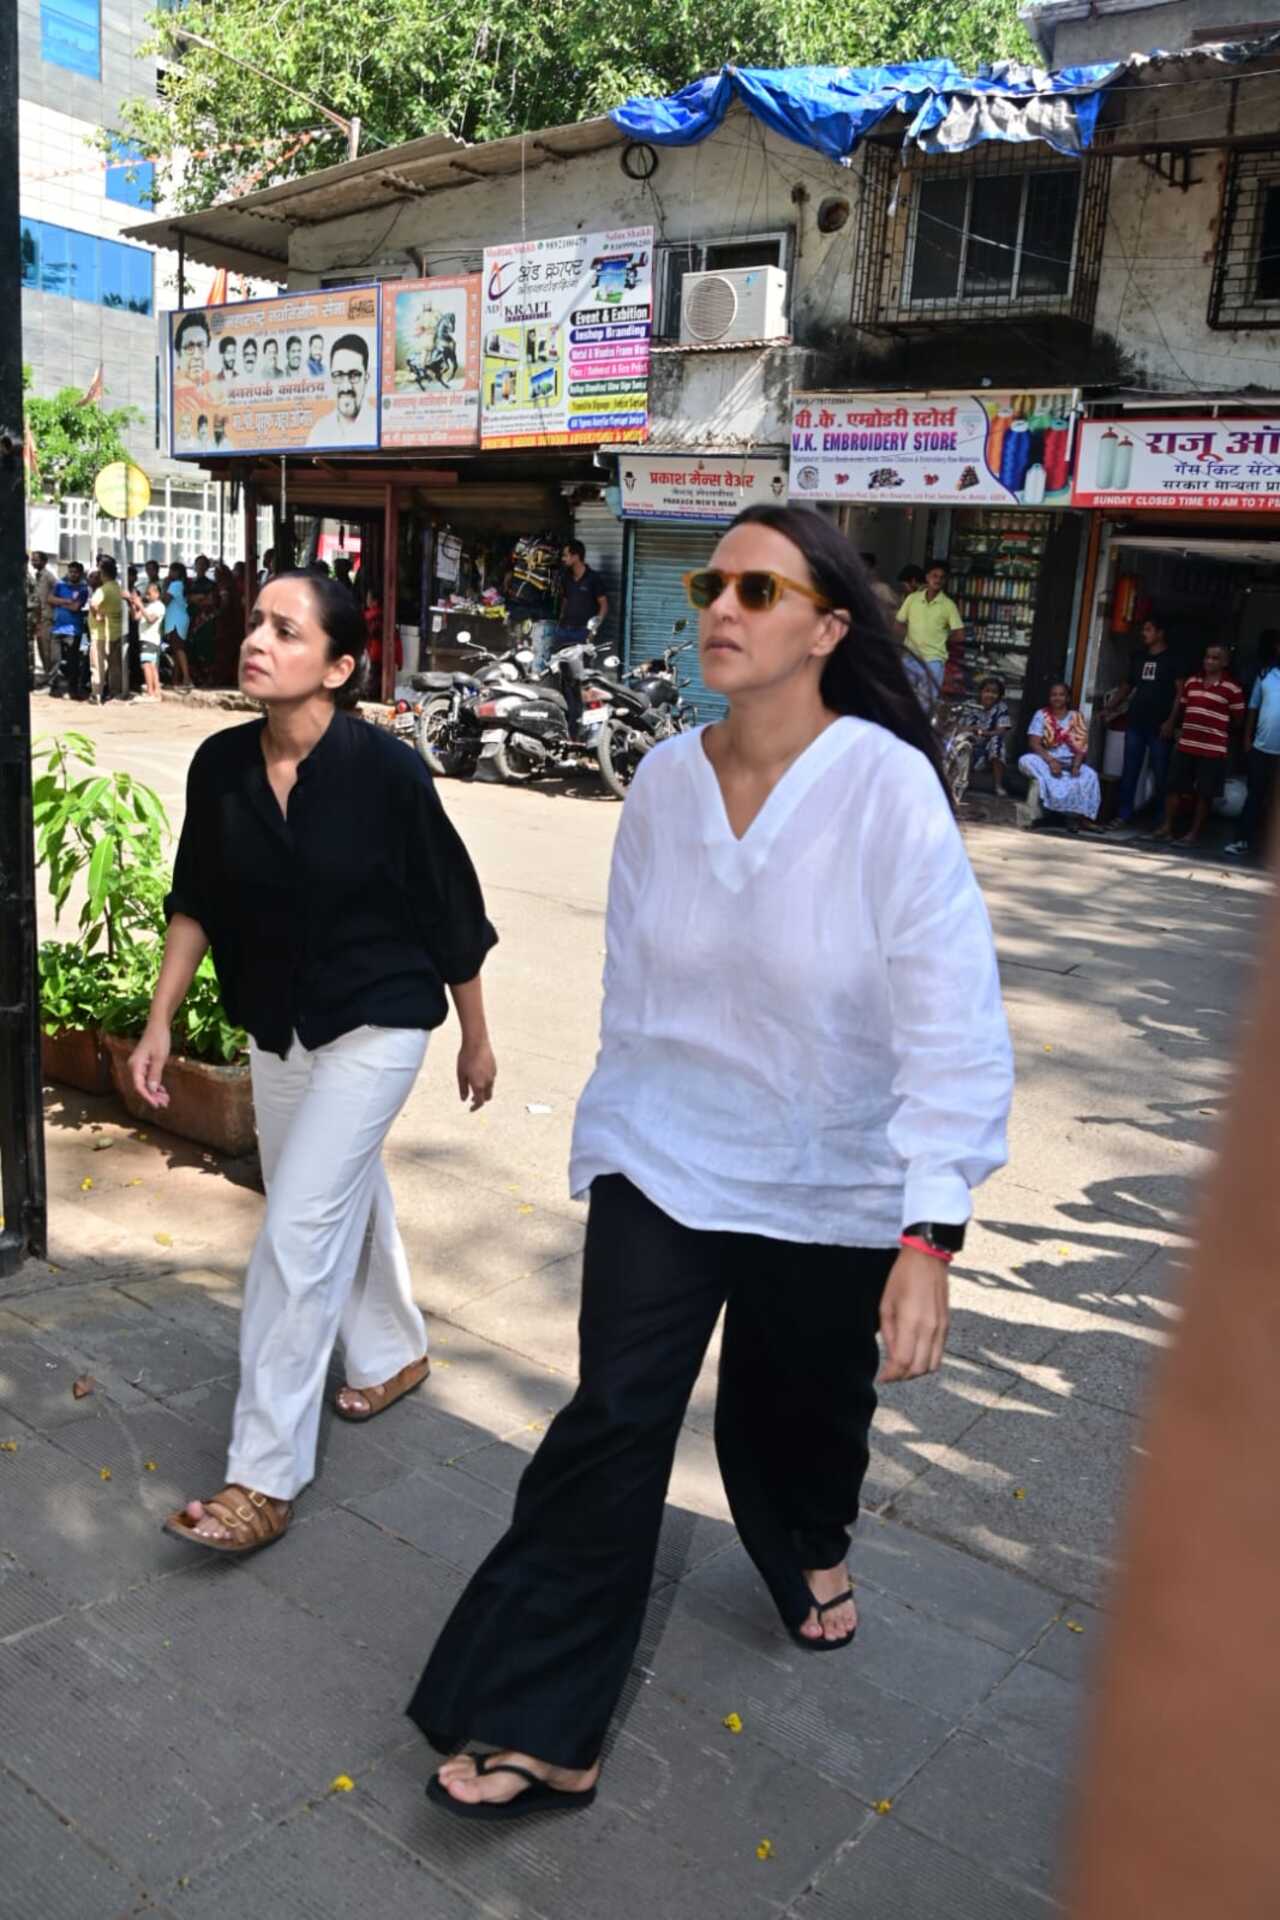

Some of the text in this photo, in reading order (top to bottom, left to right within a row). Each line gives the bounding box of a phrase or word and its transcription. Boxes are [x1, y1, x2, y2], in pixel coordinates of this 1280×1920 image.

[575, 310, 600, 325] Event
[602, 309, 610, 322] &
[605, 324, 647, 340] Branding
[792, 431, 958, 451] V.K. EMBROIDERY STORE
[1145, 431, 1223, 462] राजू
[1207, 460, 1242, 477] किट
[650, 471, 686, 486] प्रकाश
[689, 469, 721, 487] मेन्स
[1162, 479, 1211, 492] सरकार
[1093, 495, 1133, 506] SUNDAY
[1135, 495, 1176, 506] CLOSED
[1178, 496, 1205, 507] TIME
[1207, 496, 1220, 508] 10
[1221, 496, 1239, 508] AM
[1241, 496, 1256, 508] TO
[1258, 497, 1266, 508] 7
